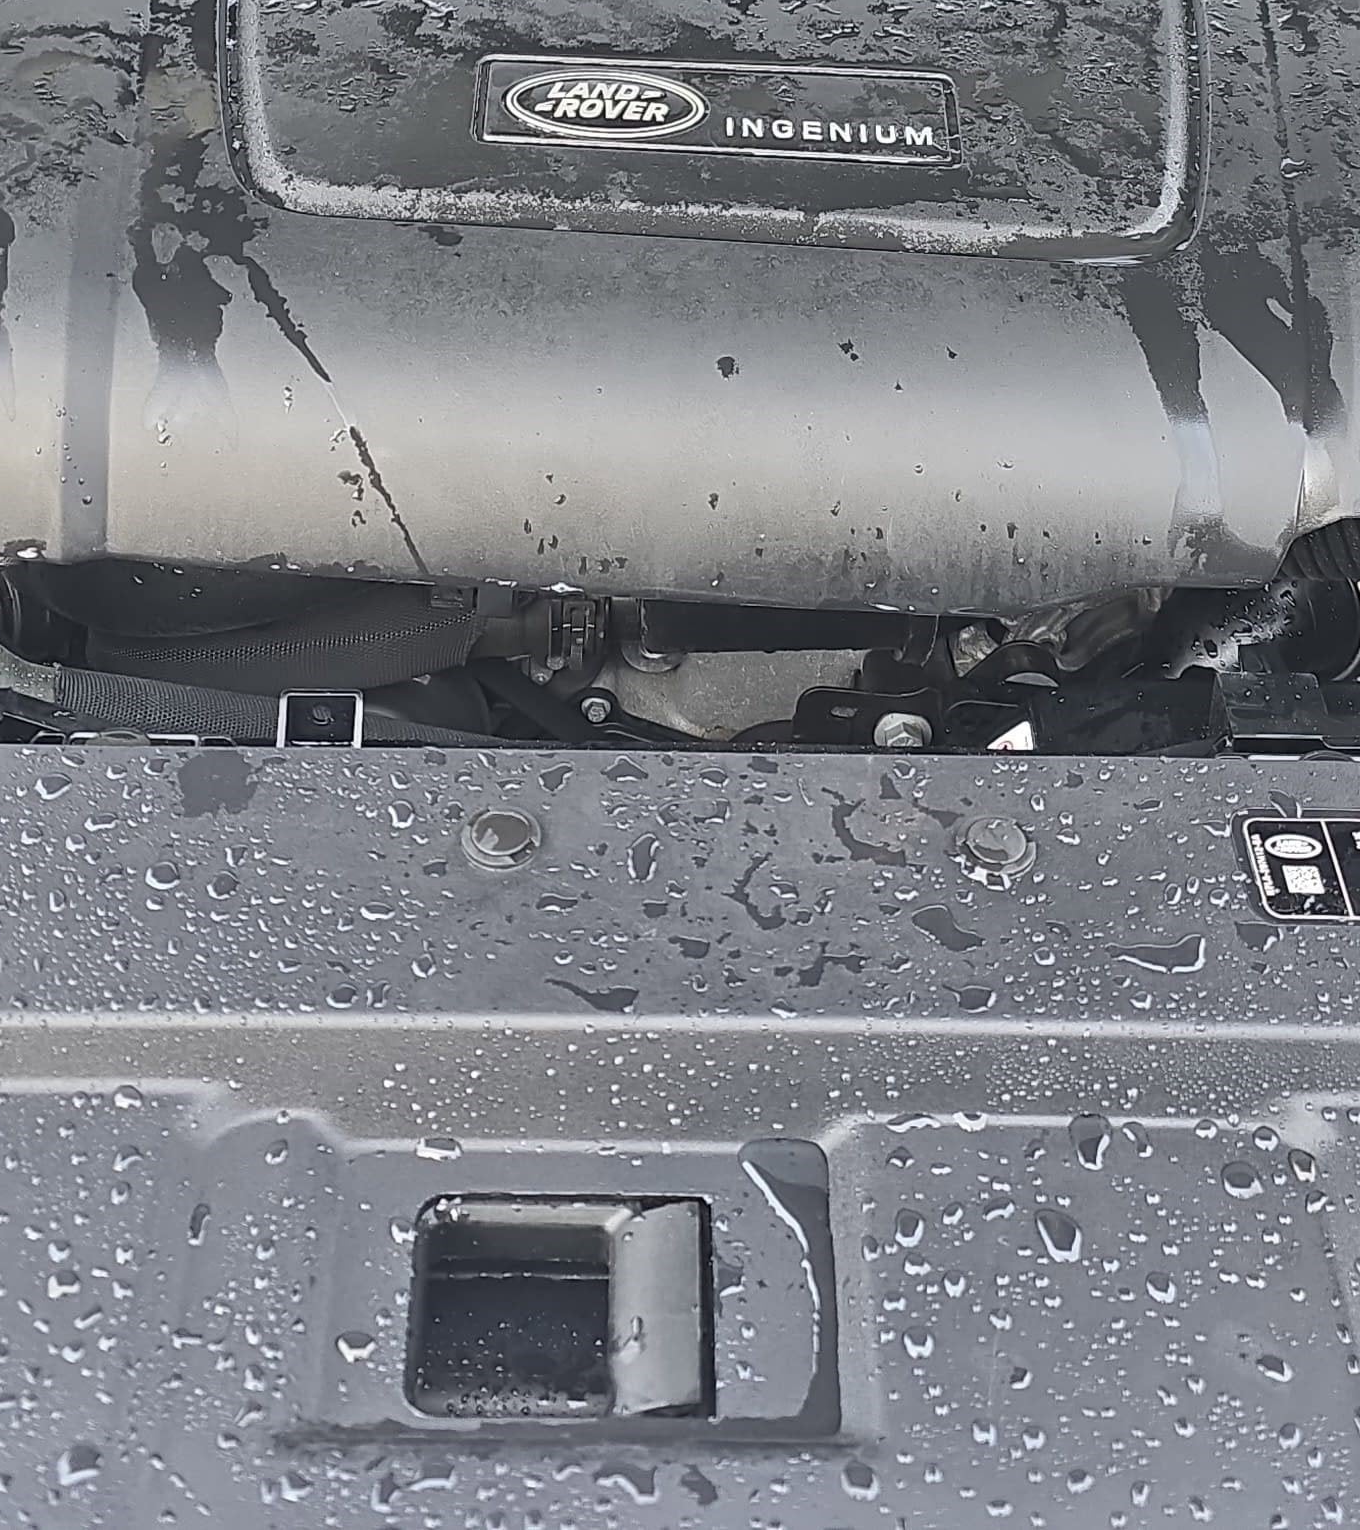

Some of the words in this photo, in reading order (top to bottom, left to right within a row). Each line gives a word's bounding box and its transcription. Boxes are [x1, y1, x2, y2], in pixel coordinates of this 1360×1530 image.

[547, 81, 640, 101] LAND
[553, 97, 669, 122] ROVER
[724, 116, 934, 147] INGENIUM
